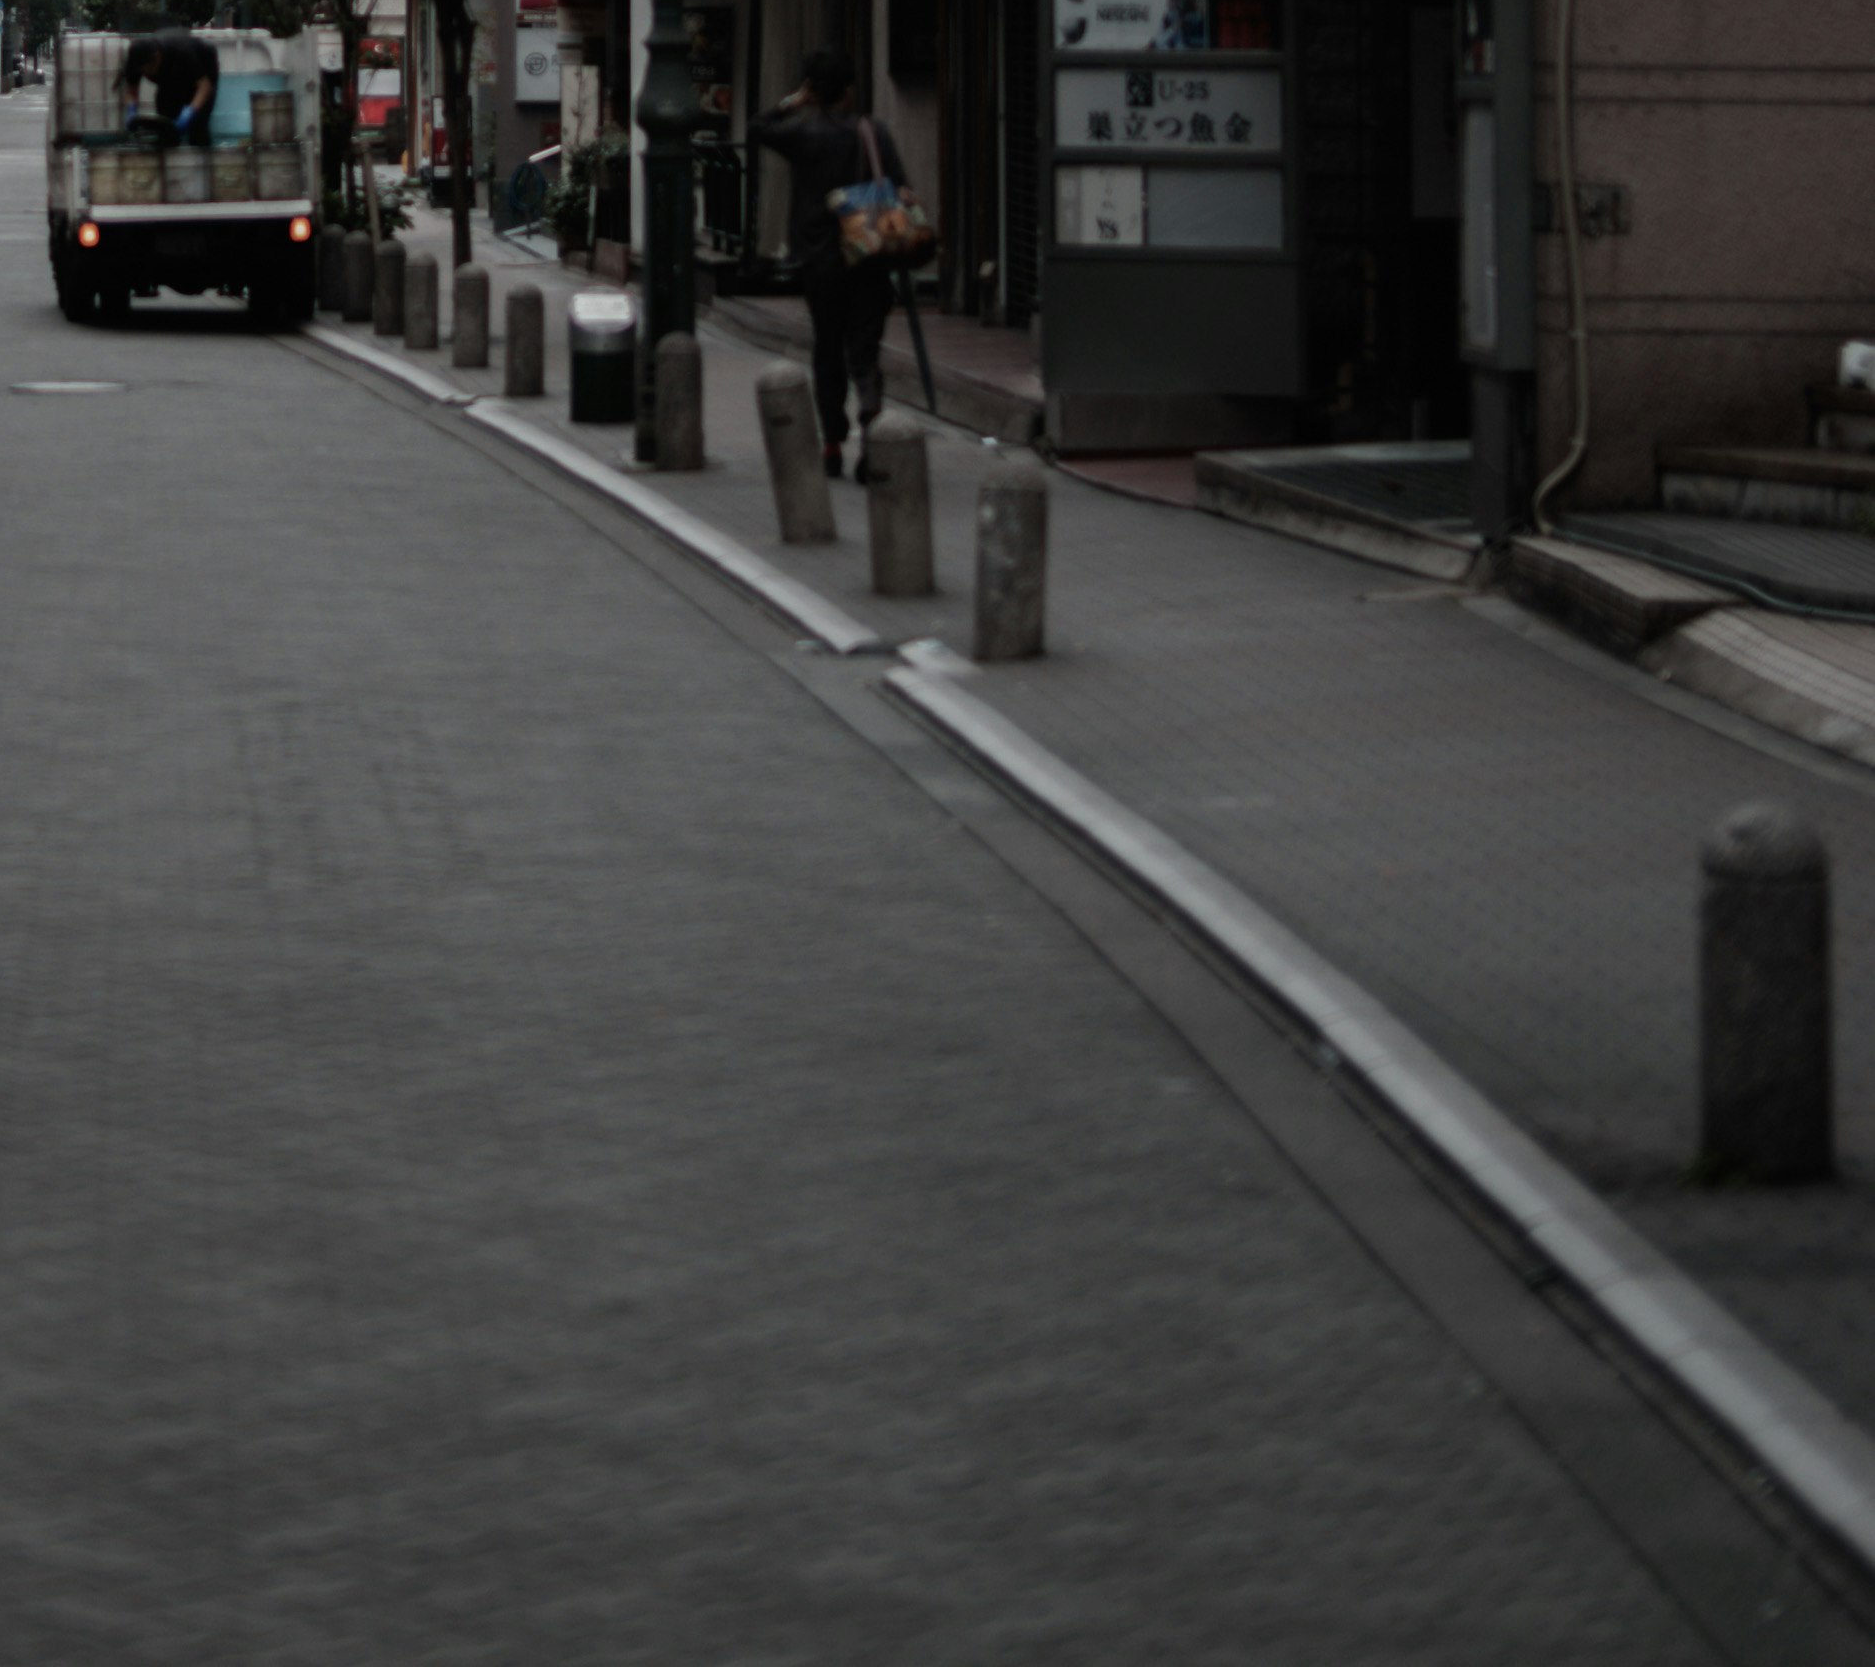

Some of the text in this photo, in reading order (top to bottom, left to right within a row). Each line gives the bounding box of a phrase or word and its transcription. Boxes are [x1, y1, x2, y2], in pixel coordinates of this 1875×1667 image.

[1158, 80, 1209, 102] U-25
[1087, 110, 1253, 144] 巣立つ魚金
